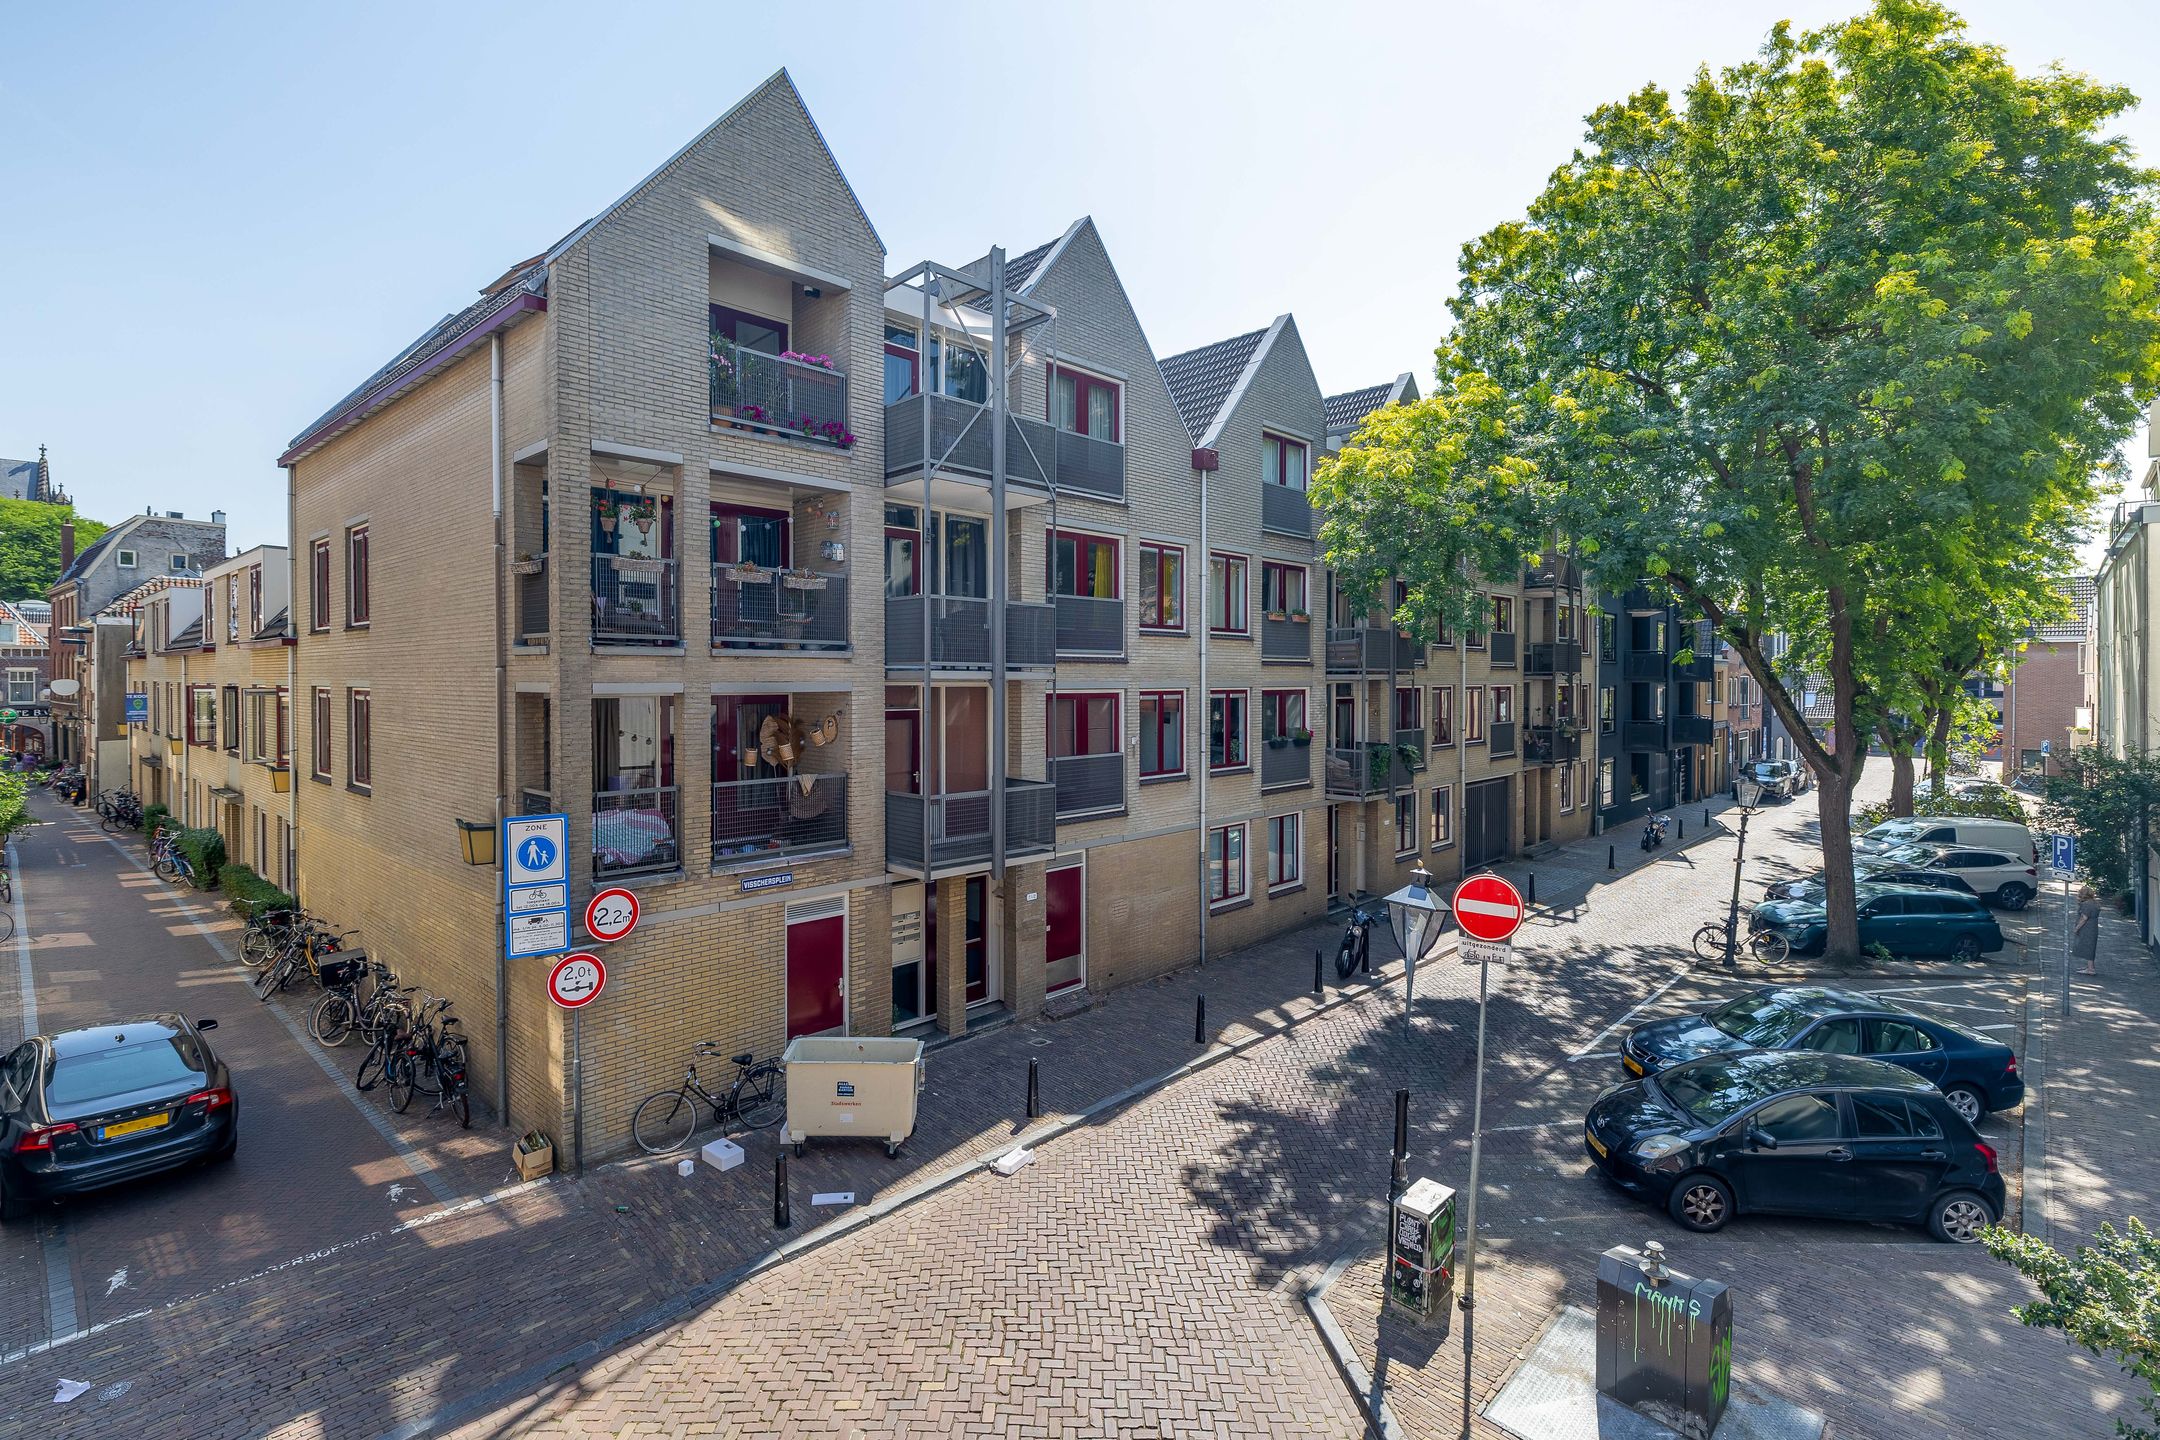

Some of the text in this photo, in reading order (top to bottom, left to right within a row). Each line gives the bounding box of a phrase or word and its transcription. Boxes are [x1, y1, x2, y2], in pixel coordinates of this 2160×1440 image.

[525, 823, 548, 831] ZONE
[2056, 837, 2069, 856] P
[743, 874, 792, 889] VISSCHERSPLEIN
[1462, 940, 1506, 953] uitgezonderd
